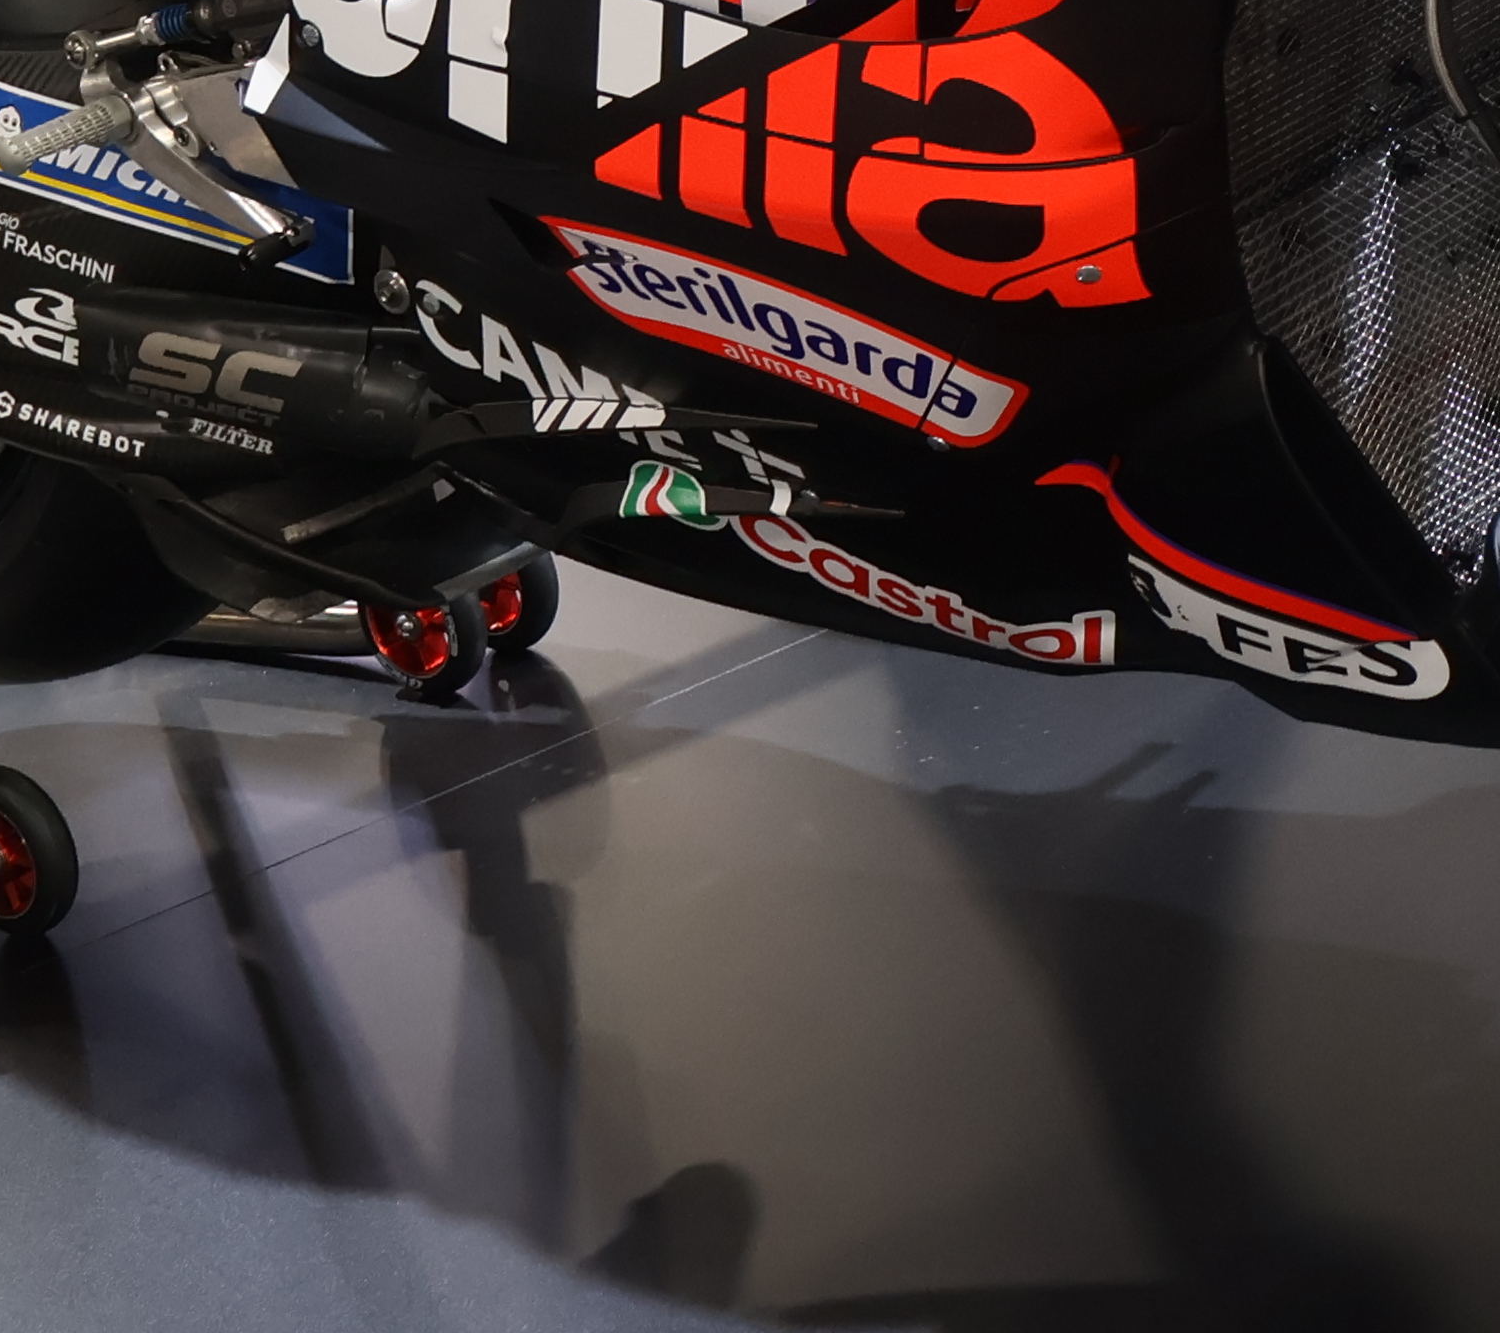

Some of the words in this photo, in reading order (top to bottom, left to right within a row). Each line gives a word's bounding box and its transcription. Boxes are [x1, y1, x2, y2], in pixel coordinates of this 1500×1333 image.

[2, 229, 116, 284] FRASCHINI
[581, 239, 980, 421] sterilgarda
[128, 331, 306, 414] SC
[722, 340, 861, 404] alimenti
[18, 402, 146, 459] SHAREBOT
[188, 417, 274, 456] FILTER
[738, 512, 1106, 664] Castrol
